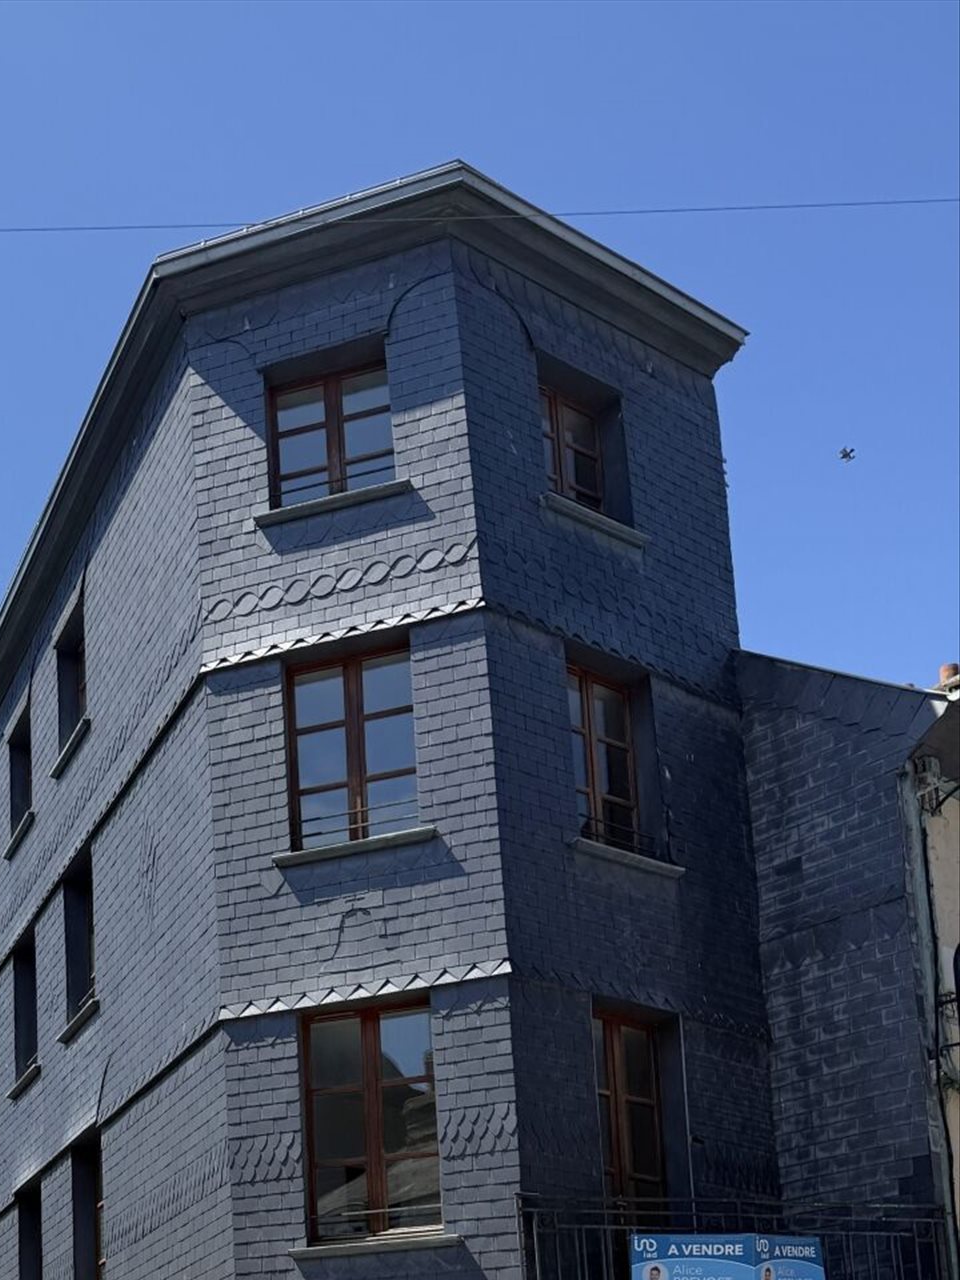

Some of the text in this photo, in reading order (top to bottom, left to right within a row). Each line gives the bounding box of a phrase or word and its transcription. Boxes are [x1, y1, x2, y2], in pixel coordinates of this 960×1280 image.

[668, 1244, 744, 1256] A VENDRE
[774, 1245, 816, 1258] A VENDRE
[673, 1264, 703, 1276] Alice
